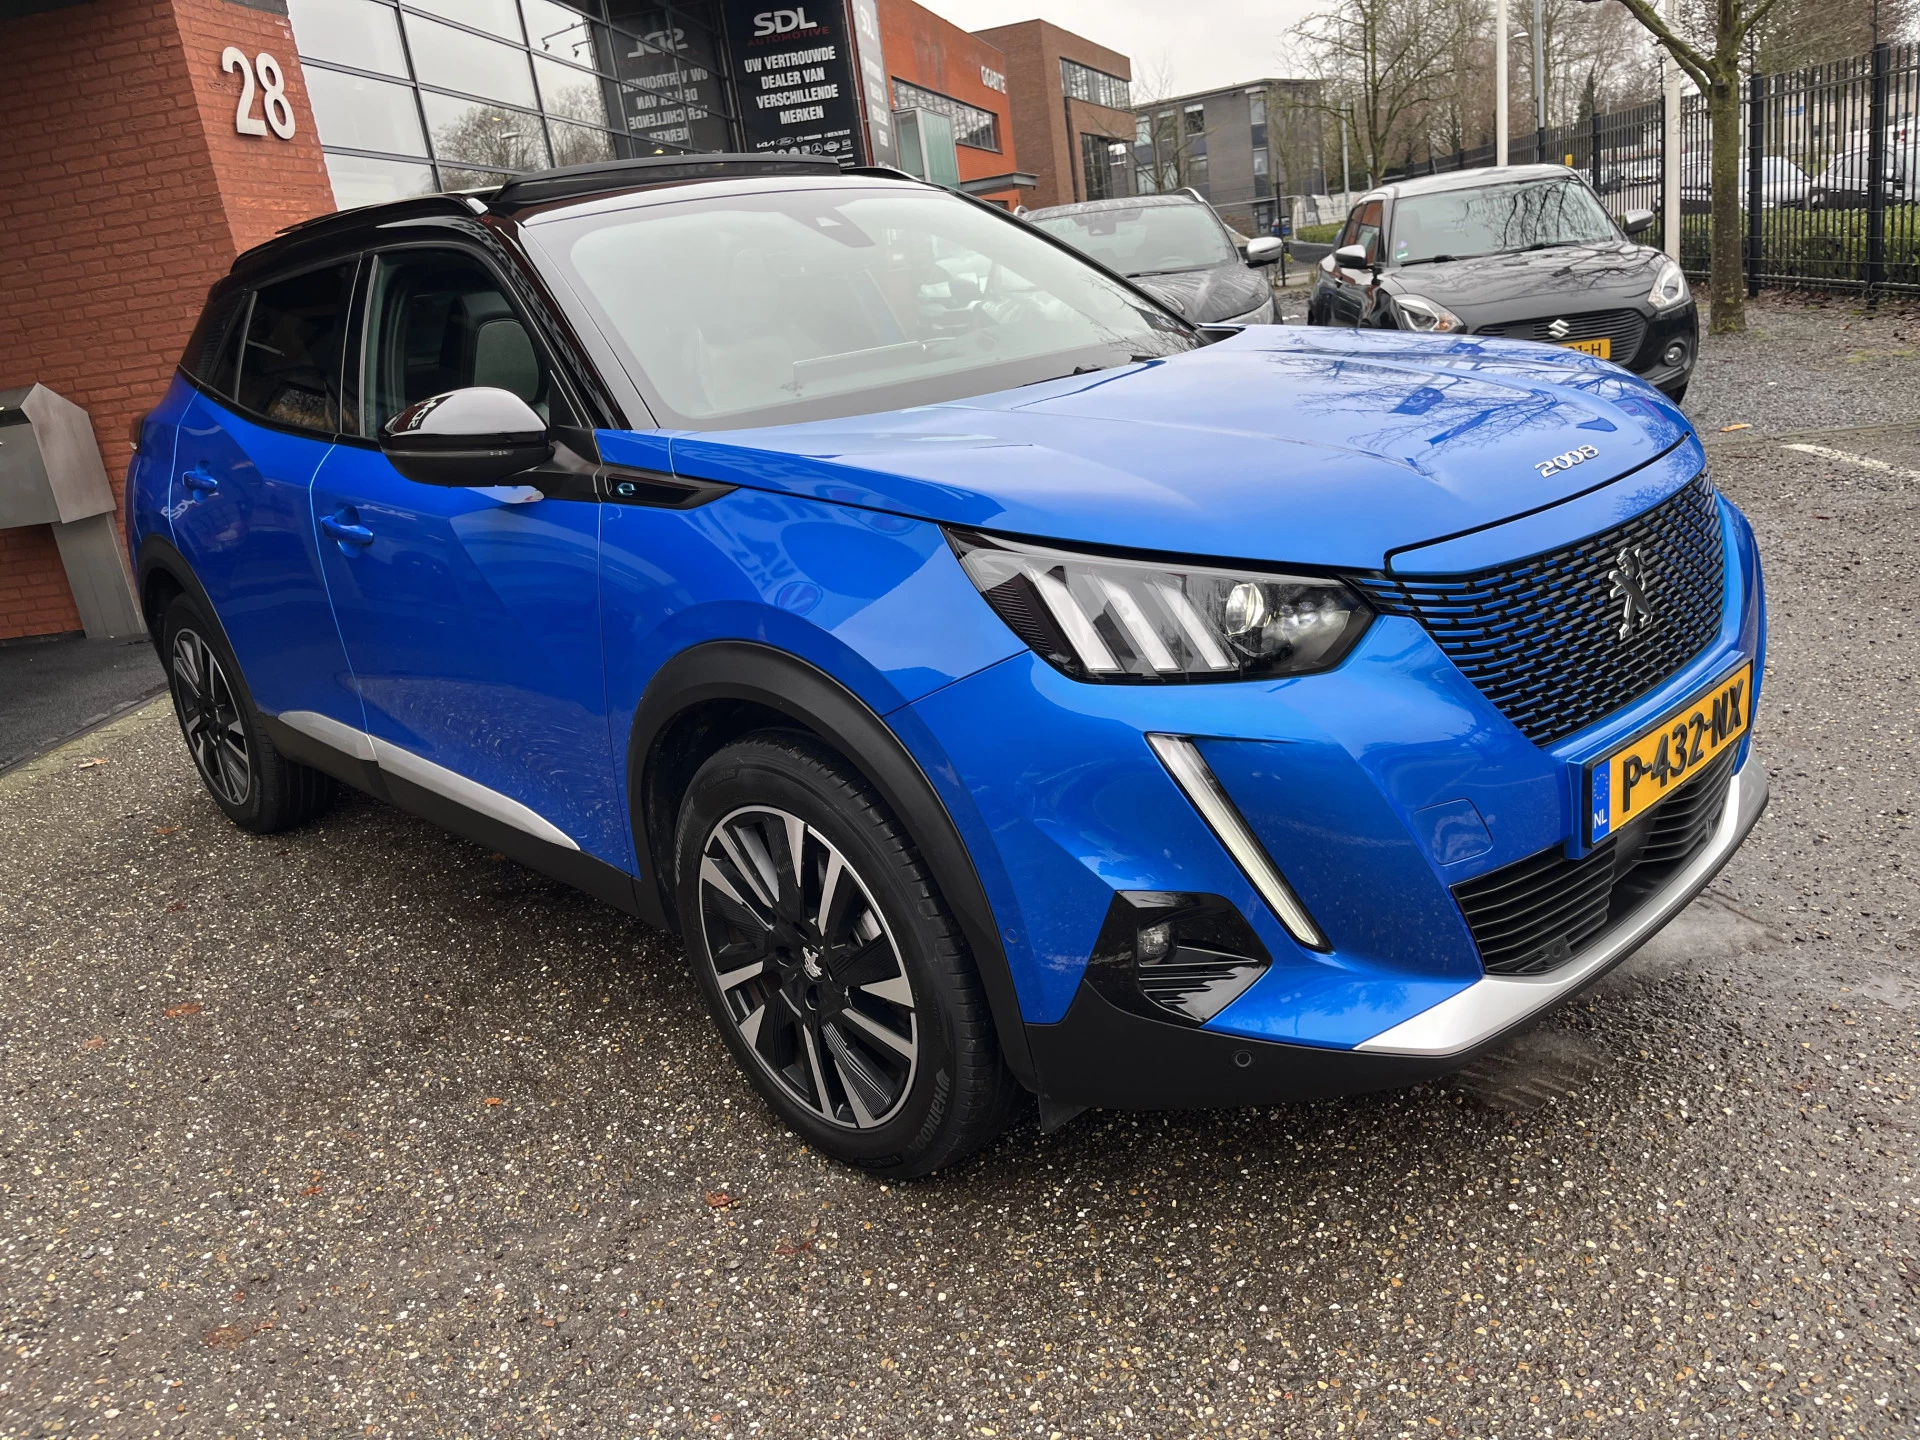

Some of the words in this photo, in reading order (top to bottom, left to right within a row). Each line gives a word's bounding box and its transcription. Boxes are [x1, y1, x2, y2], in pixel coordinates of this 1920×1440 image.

[753, 6, 818, 37] SDL
[748, 26, 831, 46] AUTOMOTIVE
[744, 57, 762, 73] UW
[764, 45, 836, 70] VERTROUWDE
[760, 71, 801, 90] DEALER
[802, 66, 825, 83] VAN
[222, 46, 296, 140] 28
[756, 84, 839, 109] VERSCHILLENDE
[779, 105, 825, 125] MERKEN
[1534, 444, 1600, 478] 2008
[1622, 678, 1745, 813] P-432-NX
[1593, 808, 1608, 829] NL
